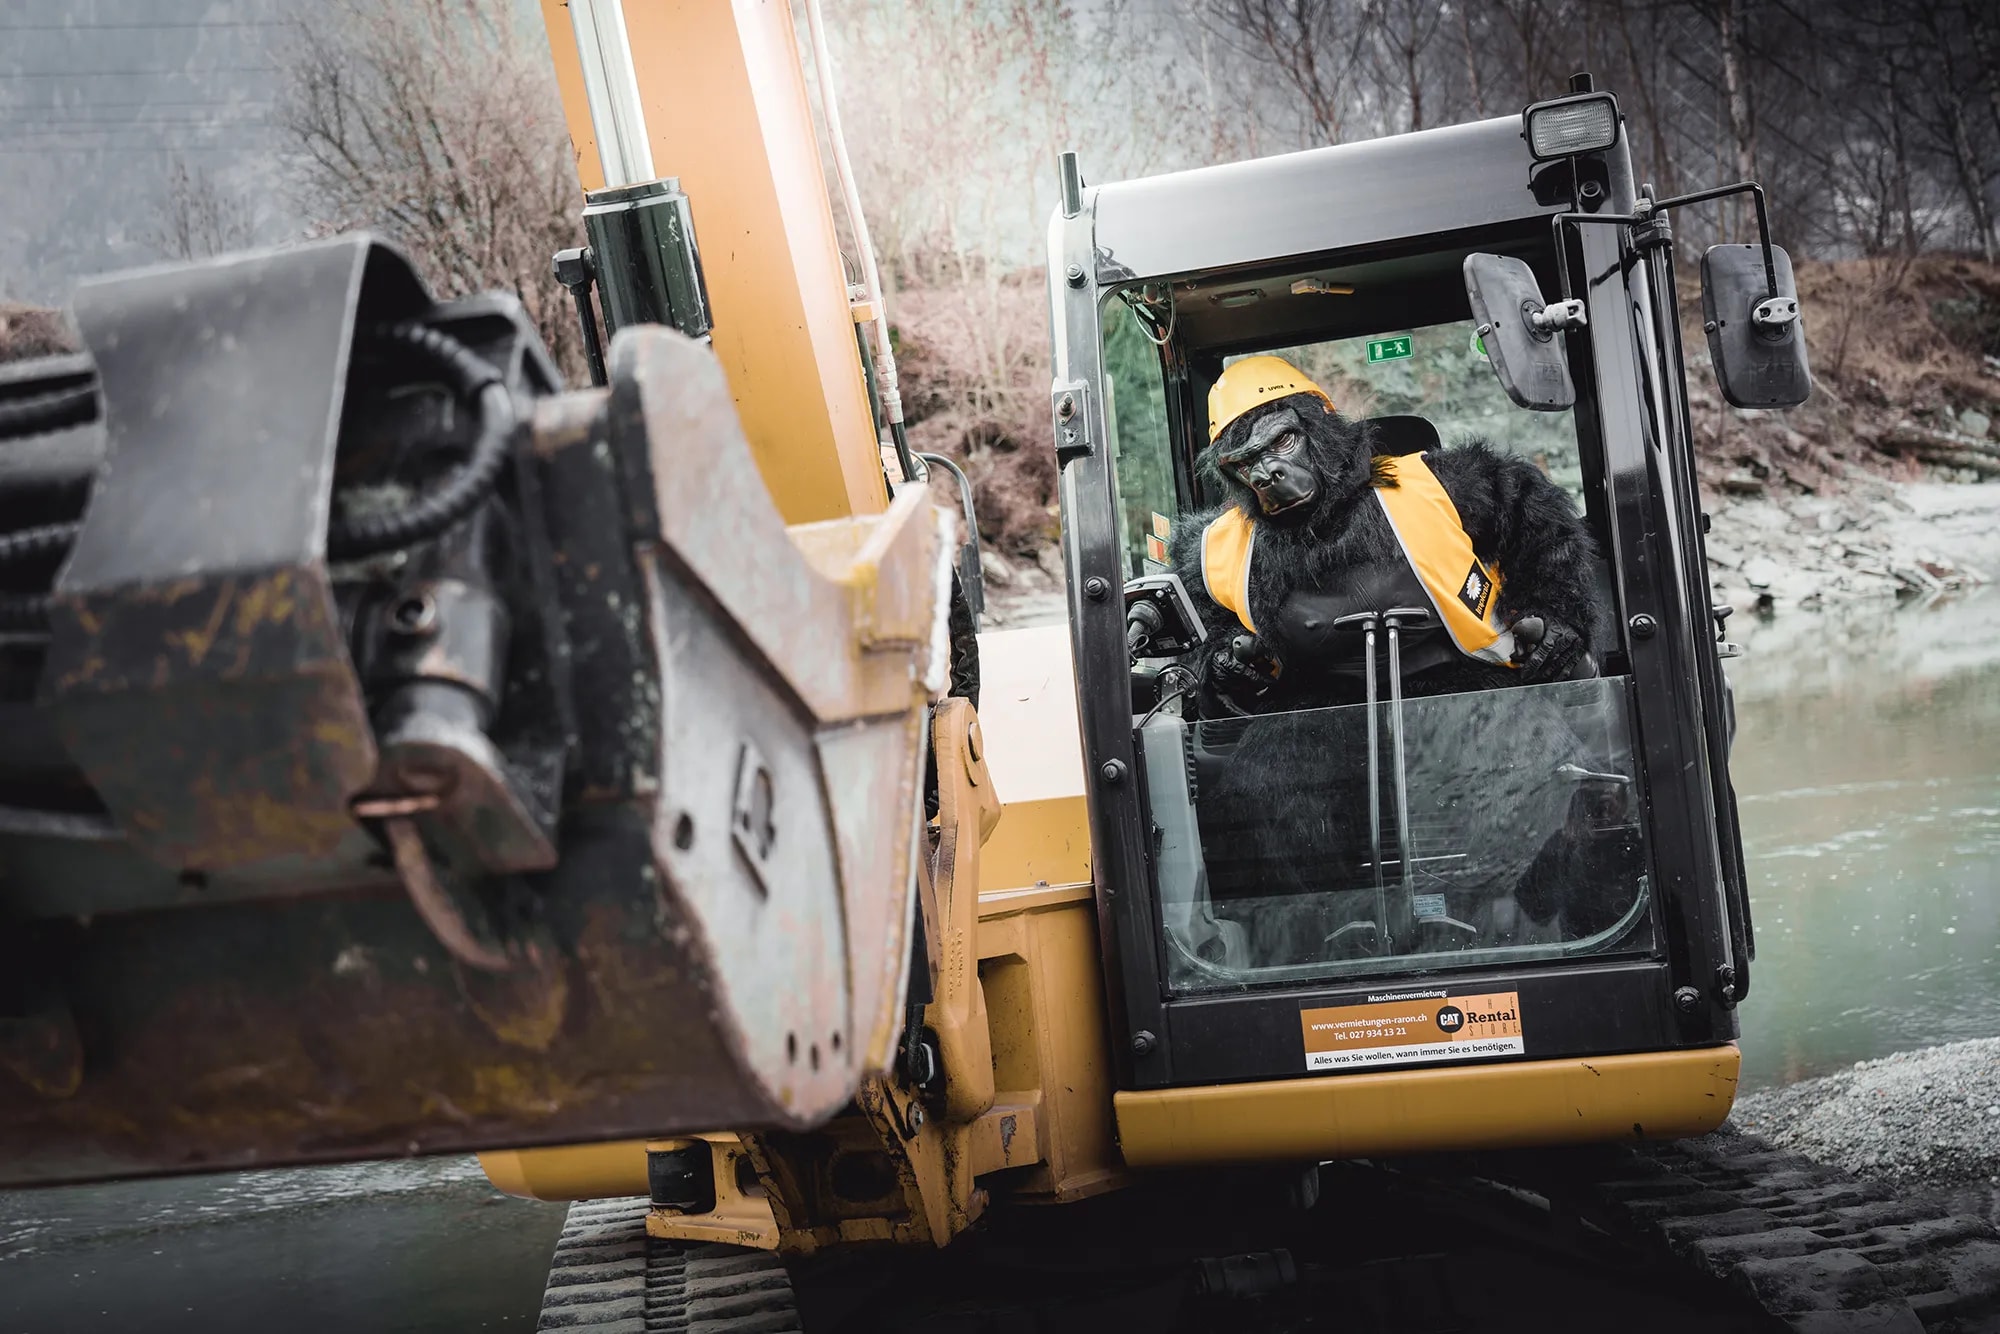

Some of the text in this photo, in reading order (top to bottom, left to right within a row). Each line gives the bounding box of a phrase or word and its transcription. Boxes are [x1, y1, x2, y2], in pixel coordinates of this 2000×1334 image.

[1367, 990, 1447, 1002] Maschinenvermietung
[1311, 1014, 1428, 1031] www.vermietungen-raron.ch
[1440, 1013, 1459, 1026] CAT
[1466, 1009, 1517, 1024] Rental
[1334, 1027, 1407, 1041] Tel. 027 934 13 21
[1314, 1057, 1332, 1065] Alles
[1351, 1053, 1364, 1062] Sie
[1366, 1052, 1394, 1060] wollen,
[1396, 1050, 1418, 1058] wann
[1420, 1048, 1446, 1056] immer
[1448, 1046, 1460, 1055] Sie
[1472, 1042, 1516, 1052] benötigen.
